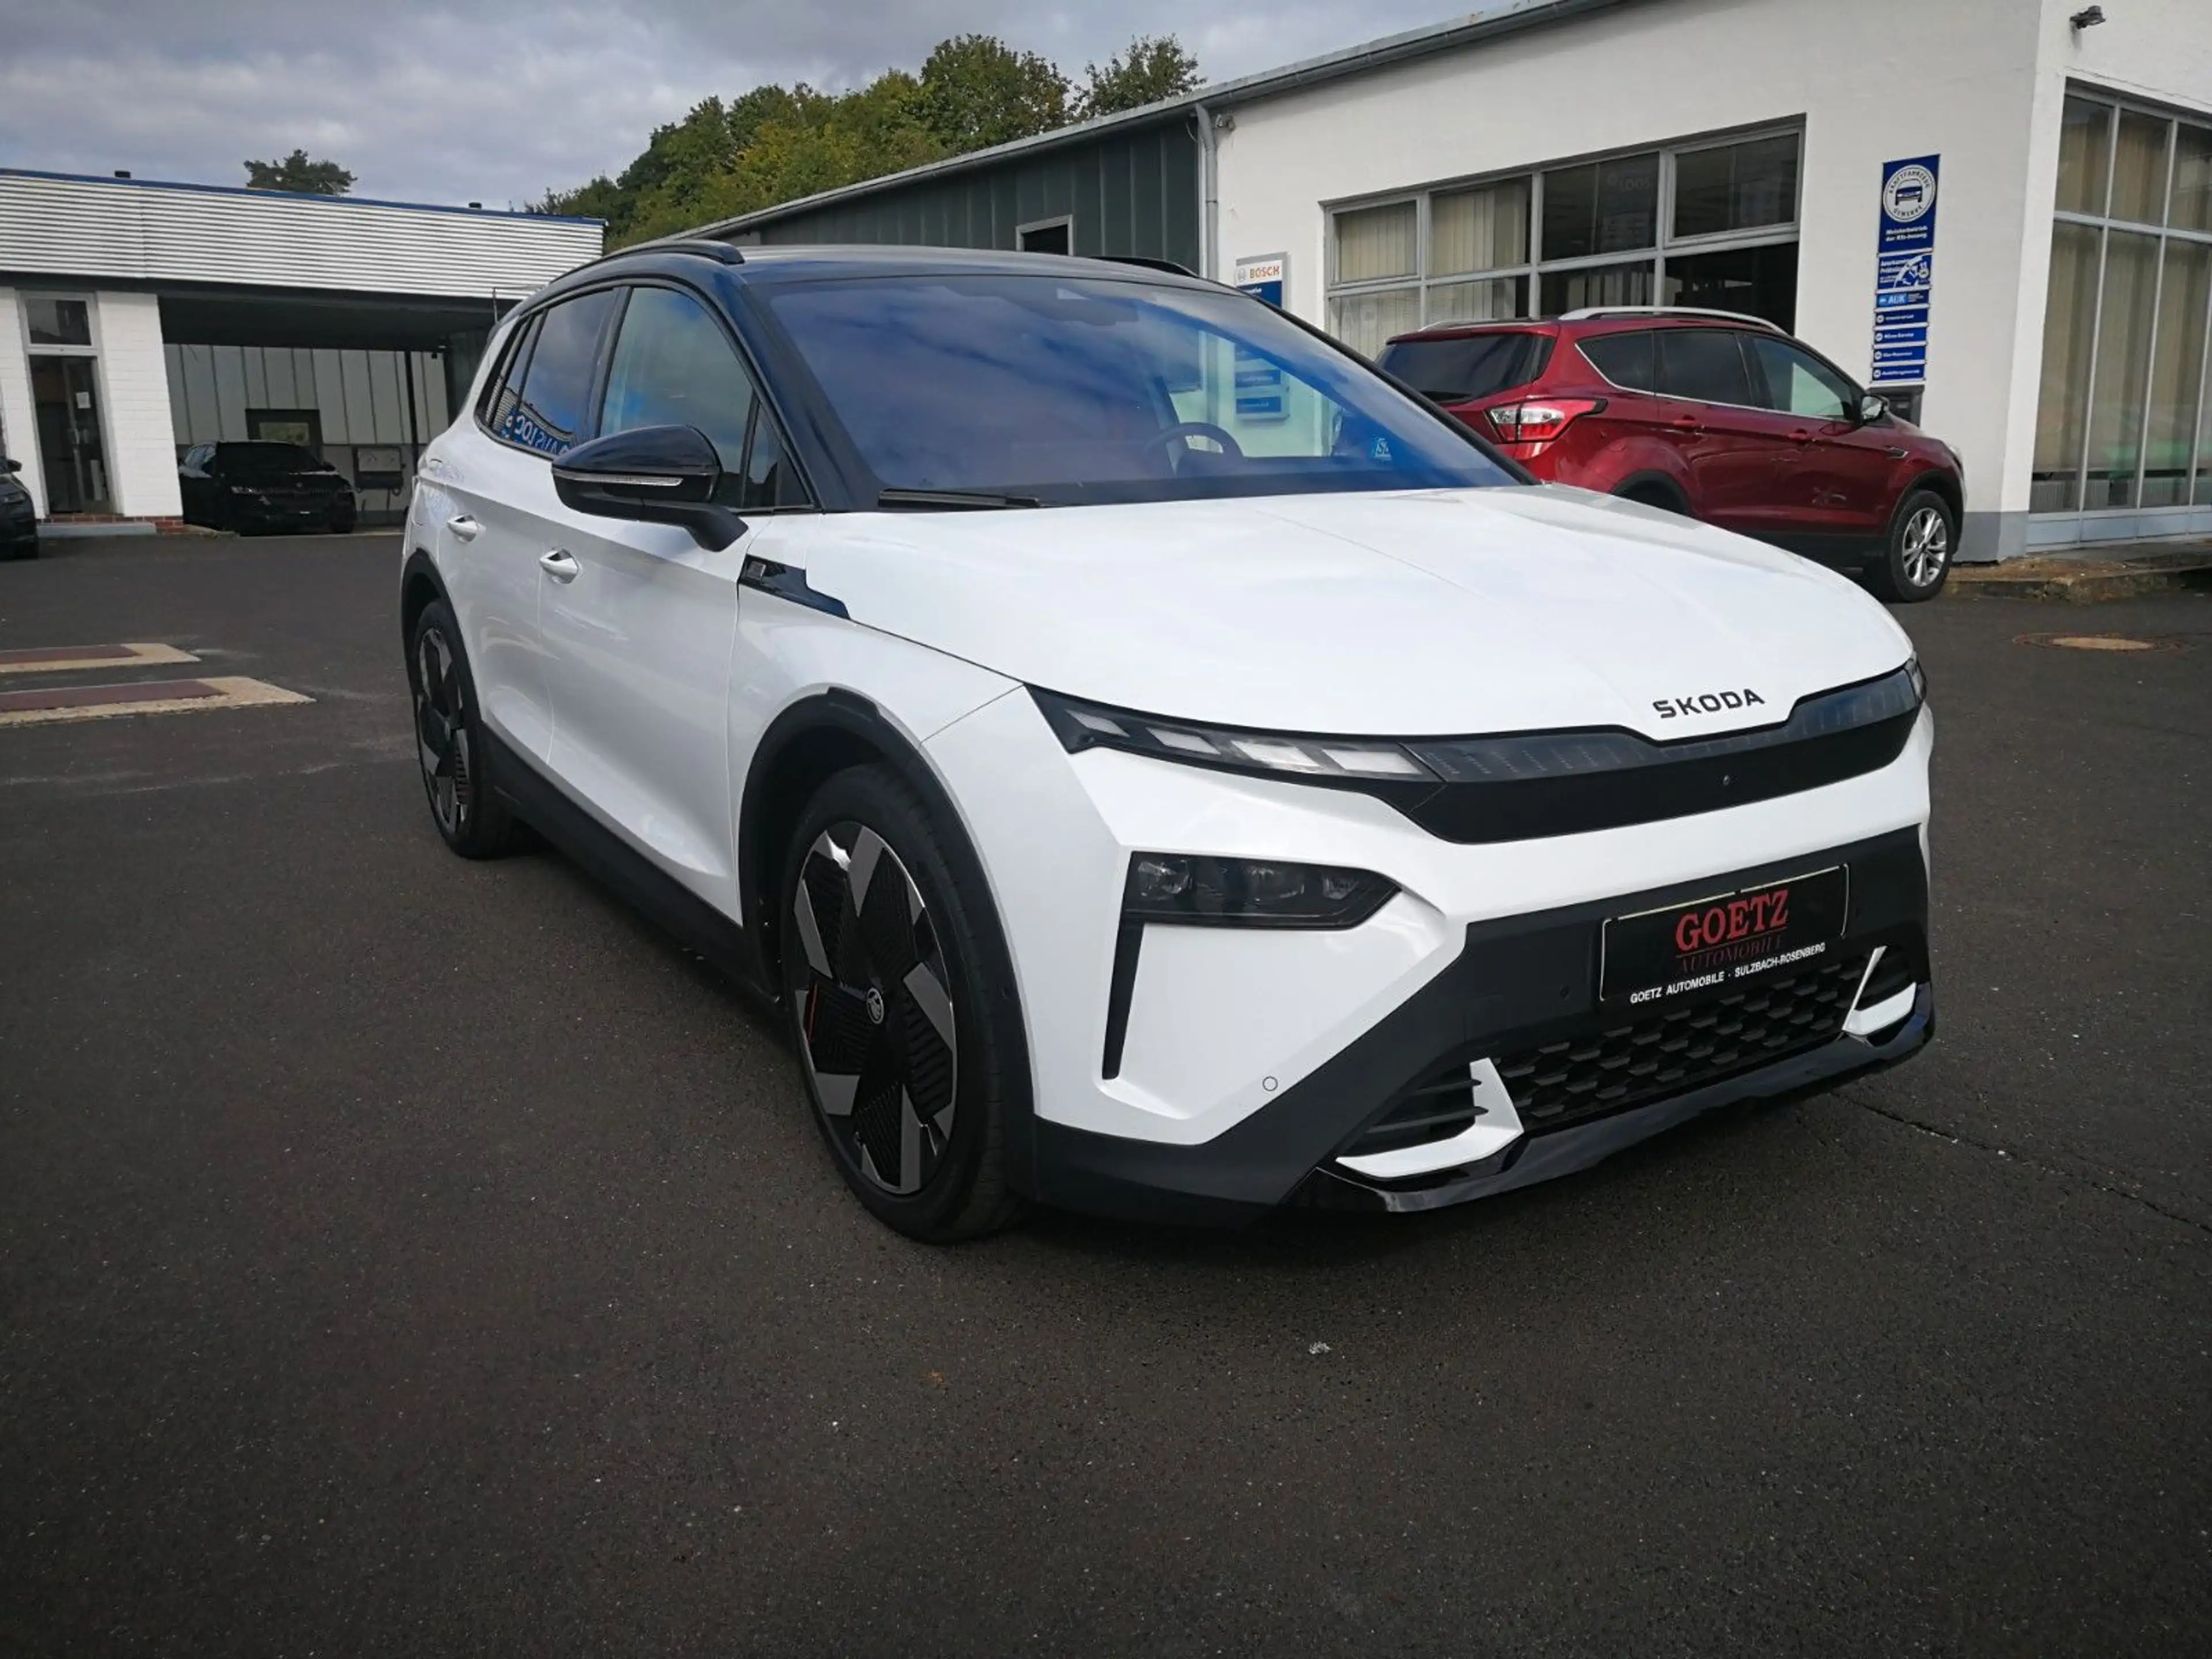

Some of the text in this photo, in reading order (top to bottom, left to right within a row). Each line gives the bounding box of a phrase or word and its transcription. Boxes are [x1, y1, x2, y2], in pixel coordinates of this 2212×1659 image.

[1249, 266, 1279, 279] BOSCH
[1675, 889, 1789, 952] GOETZ
[1630, 942, 1825, 1004] GOETZ AUTOMOBILE SULZBACH-ROSENBERG
